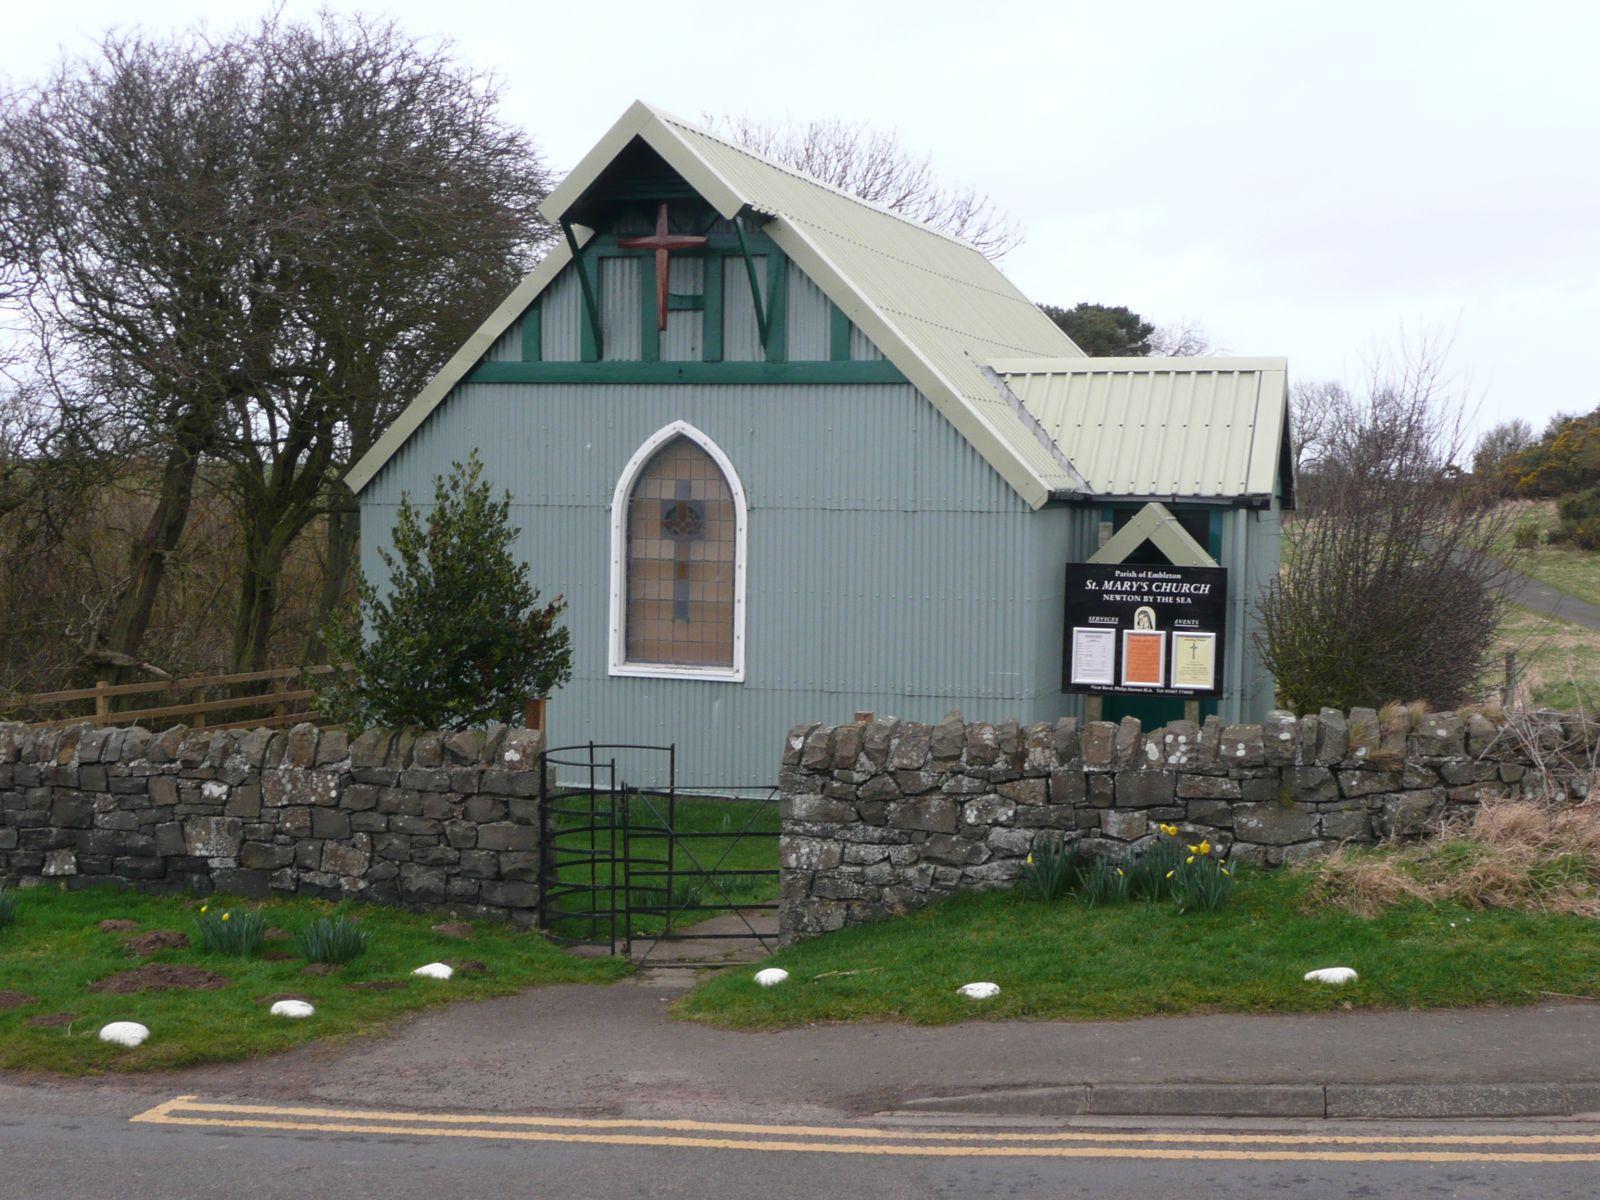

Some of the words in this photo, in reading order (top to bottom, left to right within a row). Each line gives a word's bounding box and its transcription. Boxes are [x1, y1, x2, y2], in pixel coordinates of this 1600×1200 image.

[1085, 580, 1099, 590] St.
[1102, 580, 1150, 592] MARY'S
[1152, 582, 1211, 594] CHURCH
[1103, 594, 1141, 602] NEWTON
